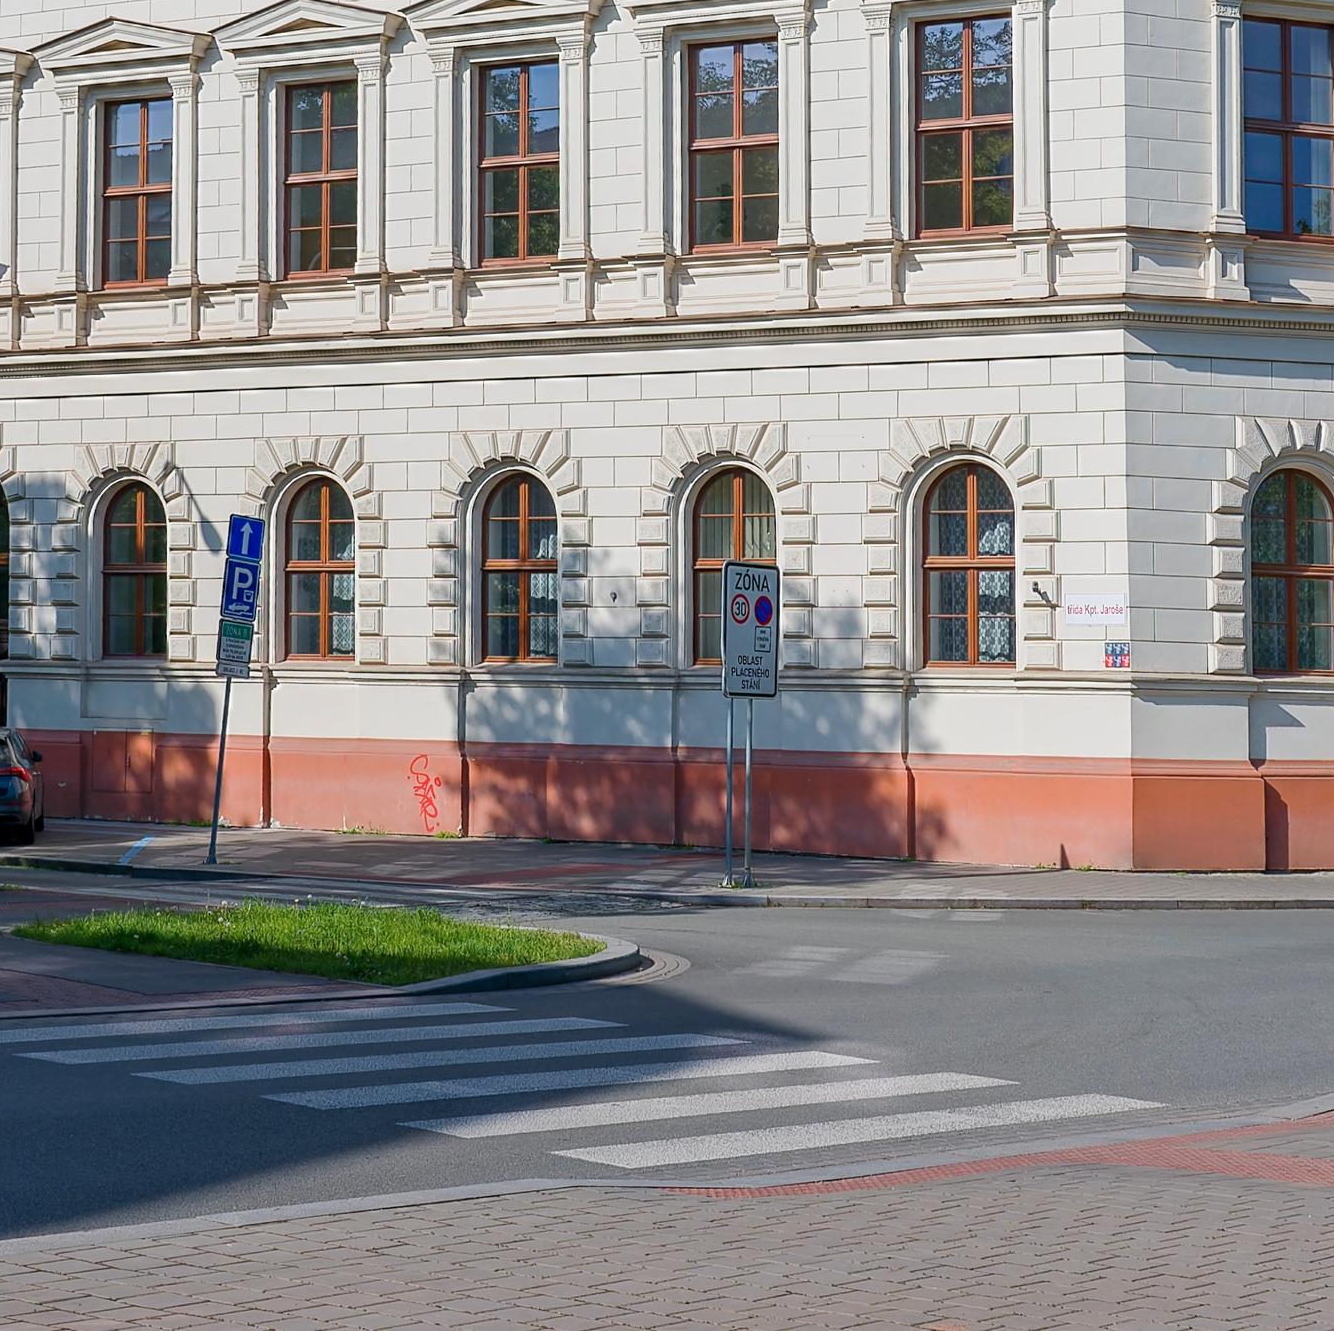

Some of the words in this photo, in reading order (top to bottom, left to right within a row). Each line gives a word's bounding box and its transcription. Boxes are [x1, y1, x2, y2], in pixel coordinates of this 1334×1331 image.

[735, 569, 770, 592] ZÓNA
[734, 601, 747, 616] 30
[737, 655, 763, 666] OBLAST
[731, 666, 770, 678] PLACENÉHO
[741, 678, 762, 690] STÁNÍ
